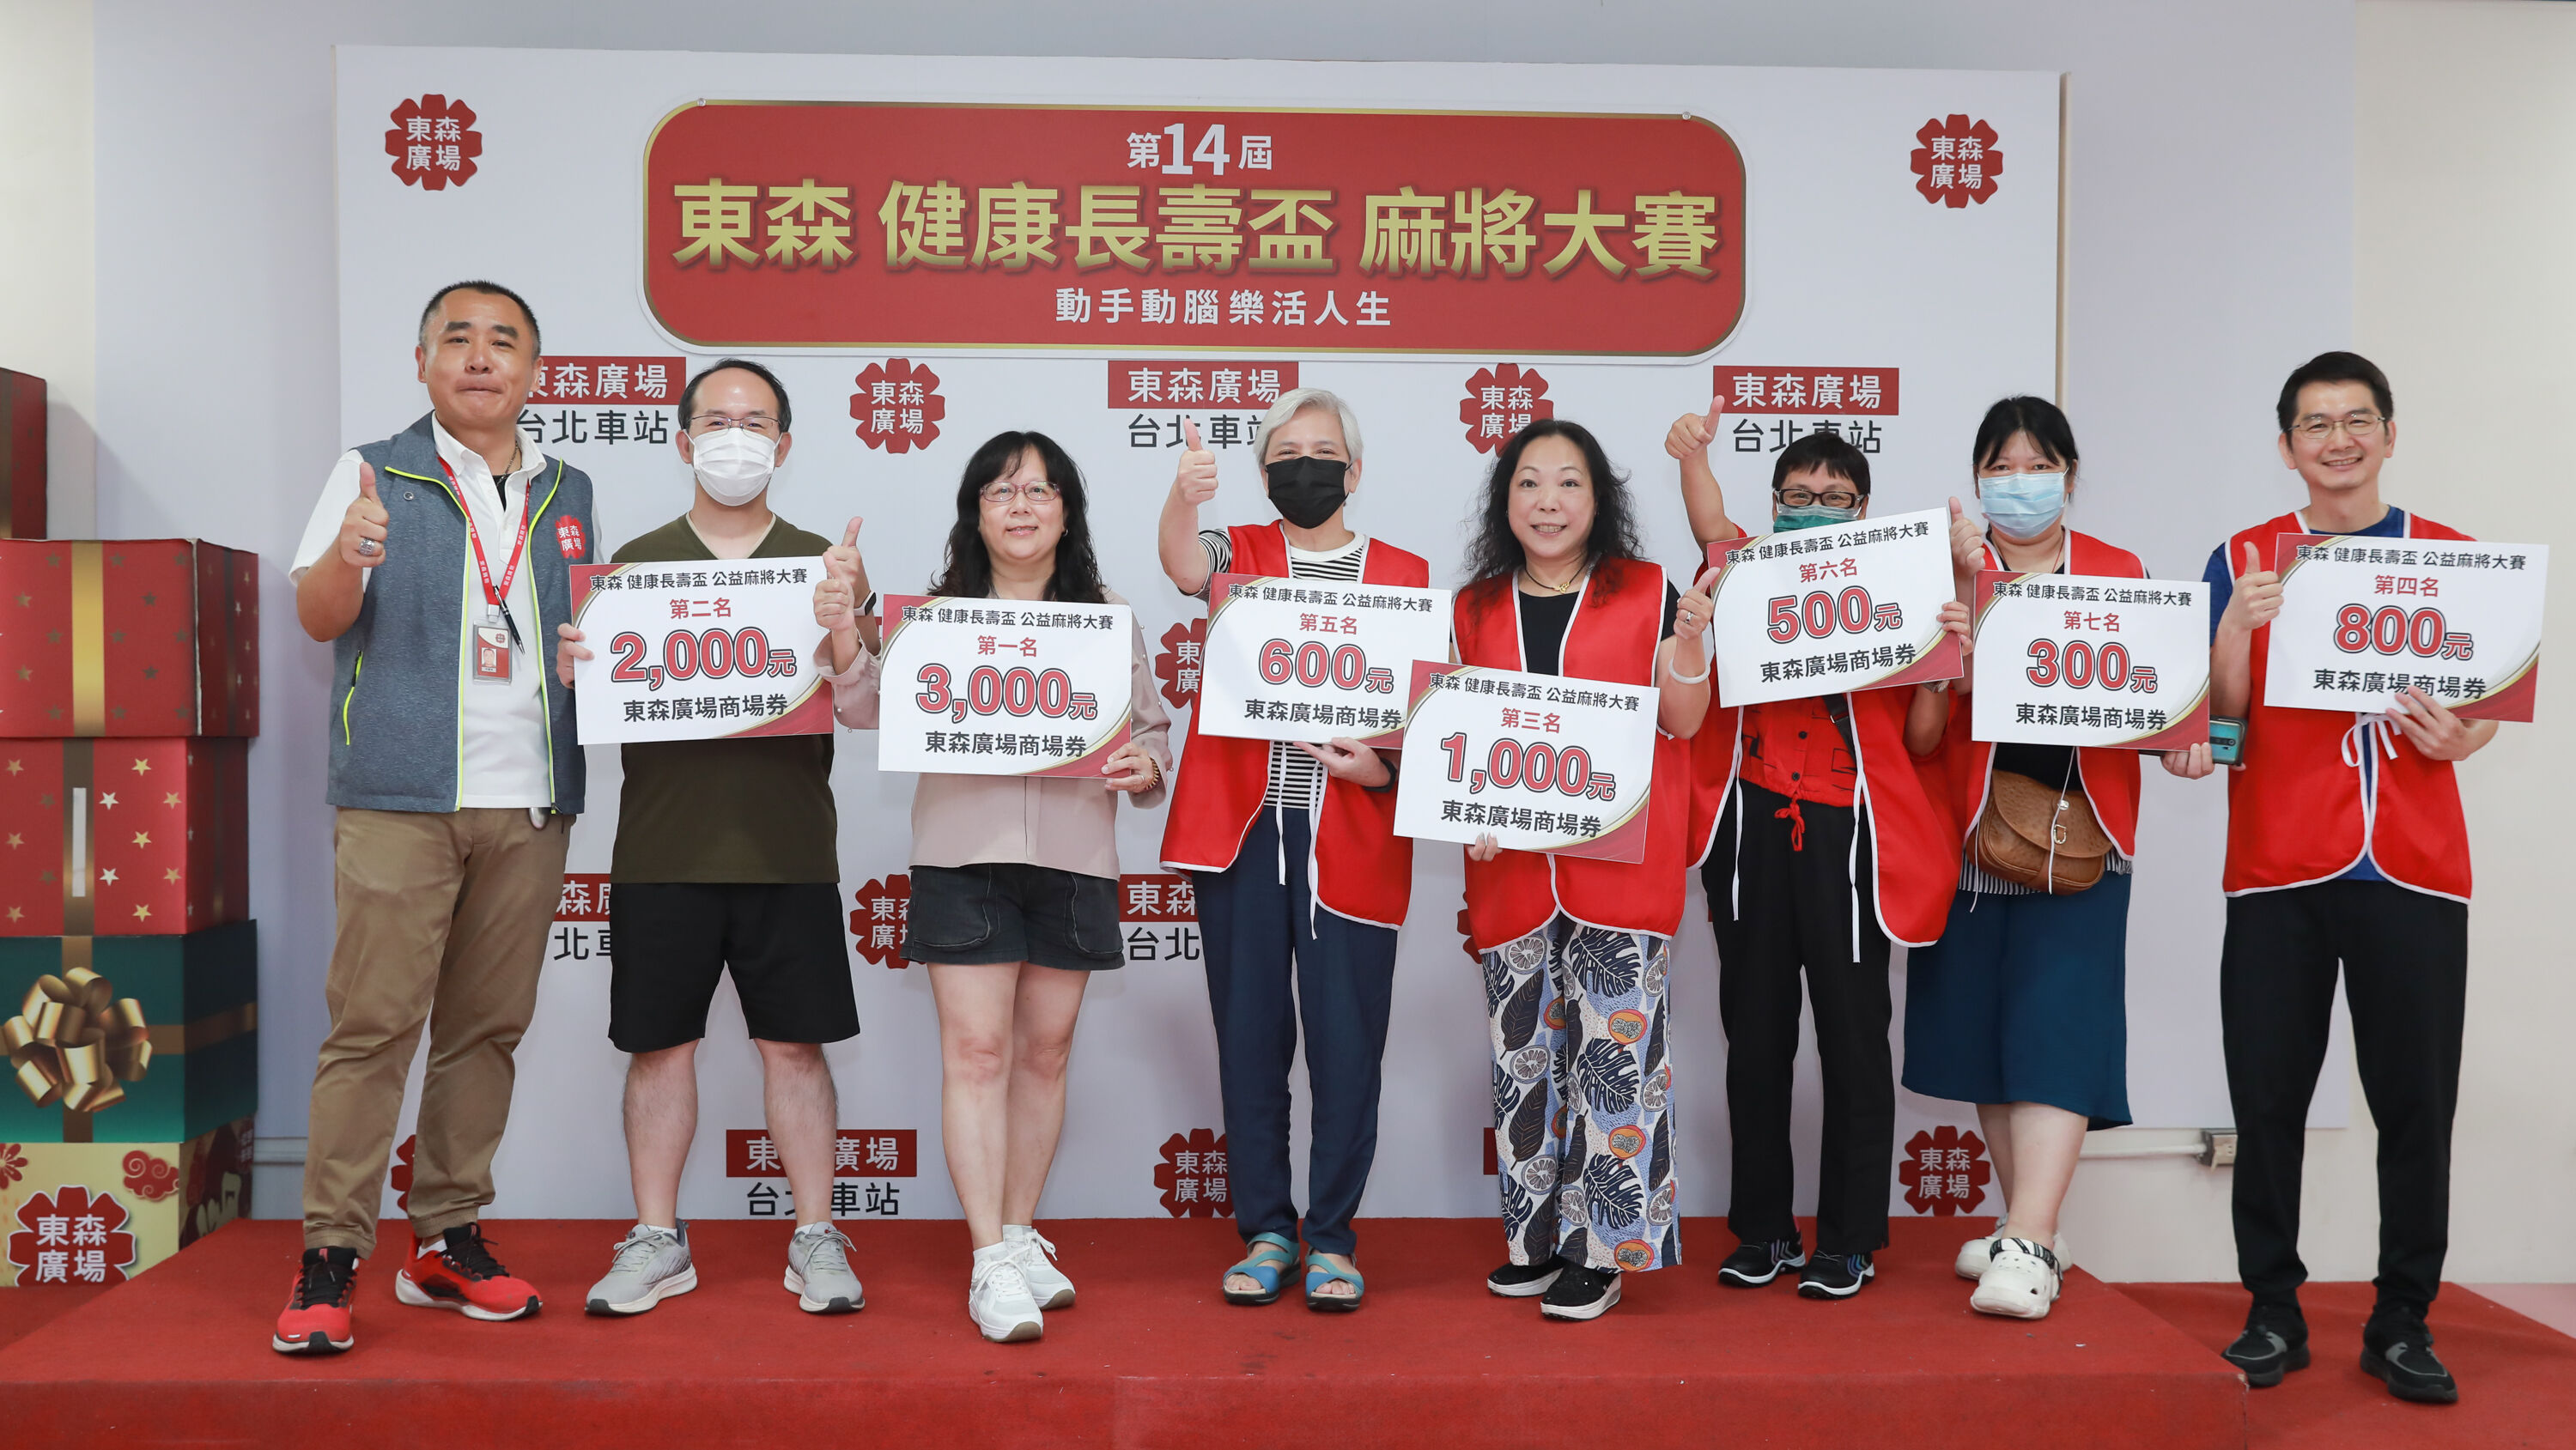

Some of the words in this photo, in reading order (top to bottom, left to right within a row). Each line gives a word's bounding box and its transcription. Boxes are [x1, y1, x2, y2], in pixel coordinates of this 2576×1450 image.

[406, 116, 461, 143] 東森
[406, 144, 461, 172] 廣場
[1127, 123, 1273, 175] 第14屆
[1931, 136, 1984, 161] 東森
[1930, 163, 1983, 189] 廣場
[672, 179, 854, 266] 東森
[878, 179, 1334, 270] 健康長壽盃
[1359, 186, 1717, 278] 麻將大賽
[1055, 288, 1391, 326] 動手動腦樂活人生
[871, 380, 924, 407] 東森
[1127, 367, 1280, 403] 東森廣場
[1480, 385, 1533, 410] 東森
[1732, 373, 1881, 409] 東森廣場
[516, 410, 668, 445] 台北車站
[871, 408, 924, 435] 廣場
[558, 525, 580, 538] 東森
[561, 537, 582, 551] 廣場
[1726, 548, 1756, 565] 東森
[1759, 536, 1834, 561] 健康長壽盃
[1838, 521, 1929, 549] 公益麻將大賽
[1799, 558, 1857, 583] 第六名
[2296, 545, 2329, 561] 東森
[2334, 547, 2417, 566] 健康長壽盃
[2423, 551, 2526, 570] 公益麻將大賽
[590, 574, 623, 592] 東森
[627, 572, 708, 590] 健康長壽盃
[712, 568, 807, 587] 公益麻將大賽
[1993, 582, 2022, 598] 東森
[2026, 584, 2099, 602] 健康長壽盃
[2104, 587, 2192, 606] 公益麻將大賽
[2374, 574, 2439, 598] 第四名
[670, 598, 731, 619] 第二名
[1228, 584, 1258, 600] 東森
[1263, 586, 1338, 606] 健康長壽盃
[1342, 592, 1432, 612] 公益麻將大賽
[902, 605, 933, 622] 東森
[938, 608, 1016, 627] 健康長壽盃
[1020, 611, 1113, 630] 公益麻將大賽
[1299, 613, 1358, 634] 第五名
[1767, 585, 1903, 644] 500元
[2063, 610, 2120, 632] 第七名
[2334, 603, 2474, 661] 800元
[611, 627, 797, 691] 2,000元
[977, 635, 1037, 658] 第一名
[1259, 638, 1394, 694] 600元
[1760, 643, 1917, 683] 東森廣場商場券
[2026, 638, 2158, 694] 300元
[915, 663, 1098, 723] 3,000元
[1429, 673, 1460, 690] 東森
[1464, 677, 1542, 701] 健康長壽盃
[1546, 687, 1639, 712] 公益麻將大賽
[2313, 669, 2486, 700] 東森廣場商場券
[623, 694, 787, 723] 東森廣場商場券
[1244, 698, 1401, 730] 東森廣場商場券
[1501, 707, 1561, 733] 第三名
[2015, 702, 2167, 730] 東森廣場商場券
[926, 731, 1086, 757] 東森廣場商場券
[1441, 731, 1615, 801] 1,000元
[1441, 799, 1601, 838] 東森廣場商場券
[746, 1137, 899, 1171] 東廣場
[1175, 1150, 1227, 1174] 東森
[1919, 1147, 1971, 1172] 東森
[1175, 1177, 1227, 1203] 廣場
[1919, 1174, 1971, 1199] 廣場
[36, 1214, 107, 1246] 東森
[35, 1249, 106, 1283] 廣場
